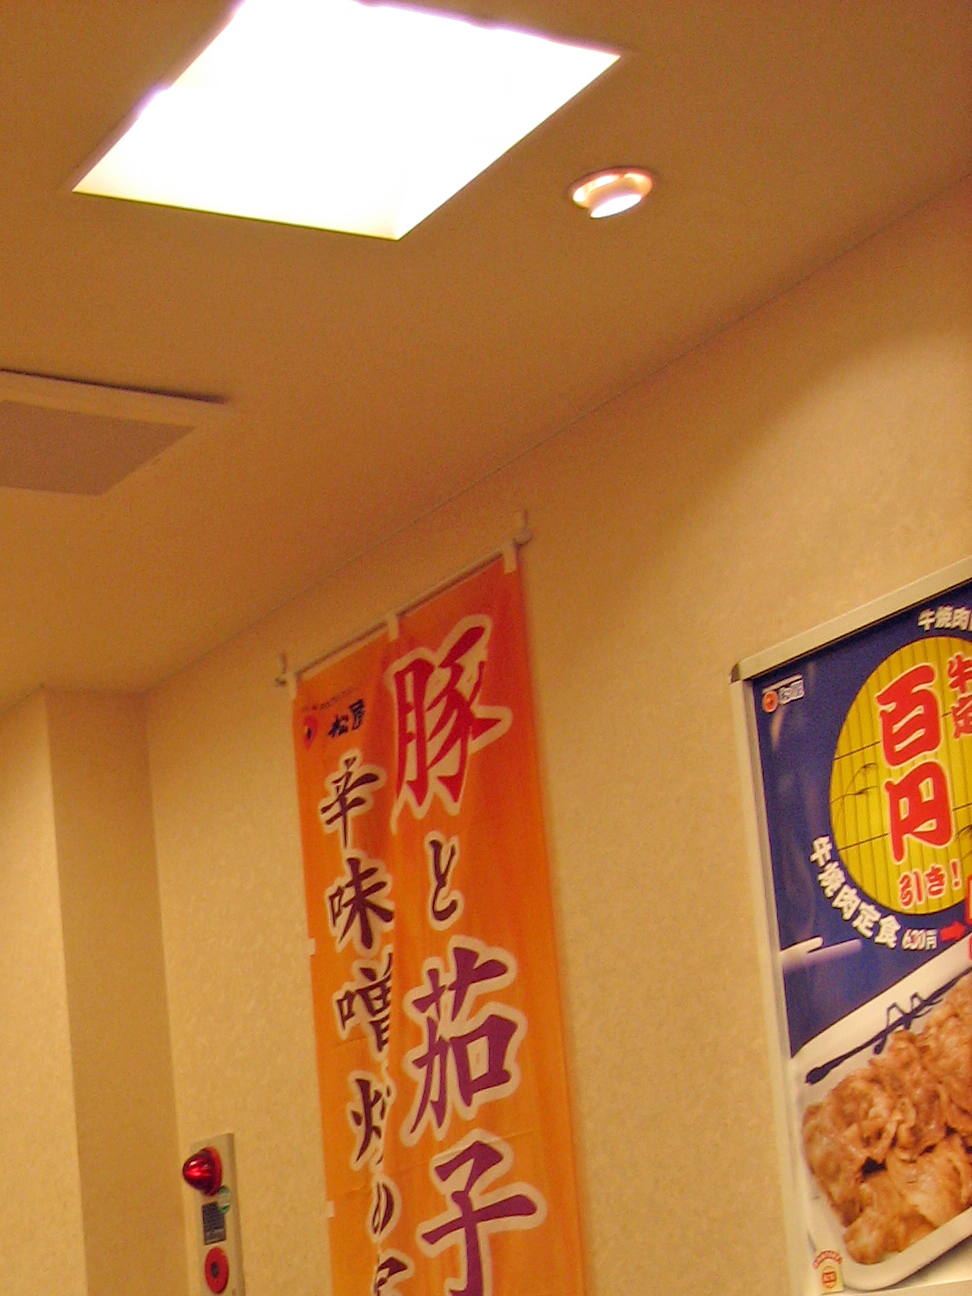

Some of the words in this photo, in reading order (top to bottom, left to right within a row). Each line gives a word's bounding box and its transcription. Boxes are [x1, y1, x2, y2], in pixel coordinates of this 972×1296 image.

[917, 605, 972, 631] 牛焼肉
[877, 665, 954, 863] 百円
[810, 835, 902, 950] 牛焼肉定食
